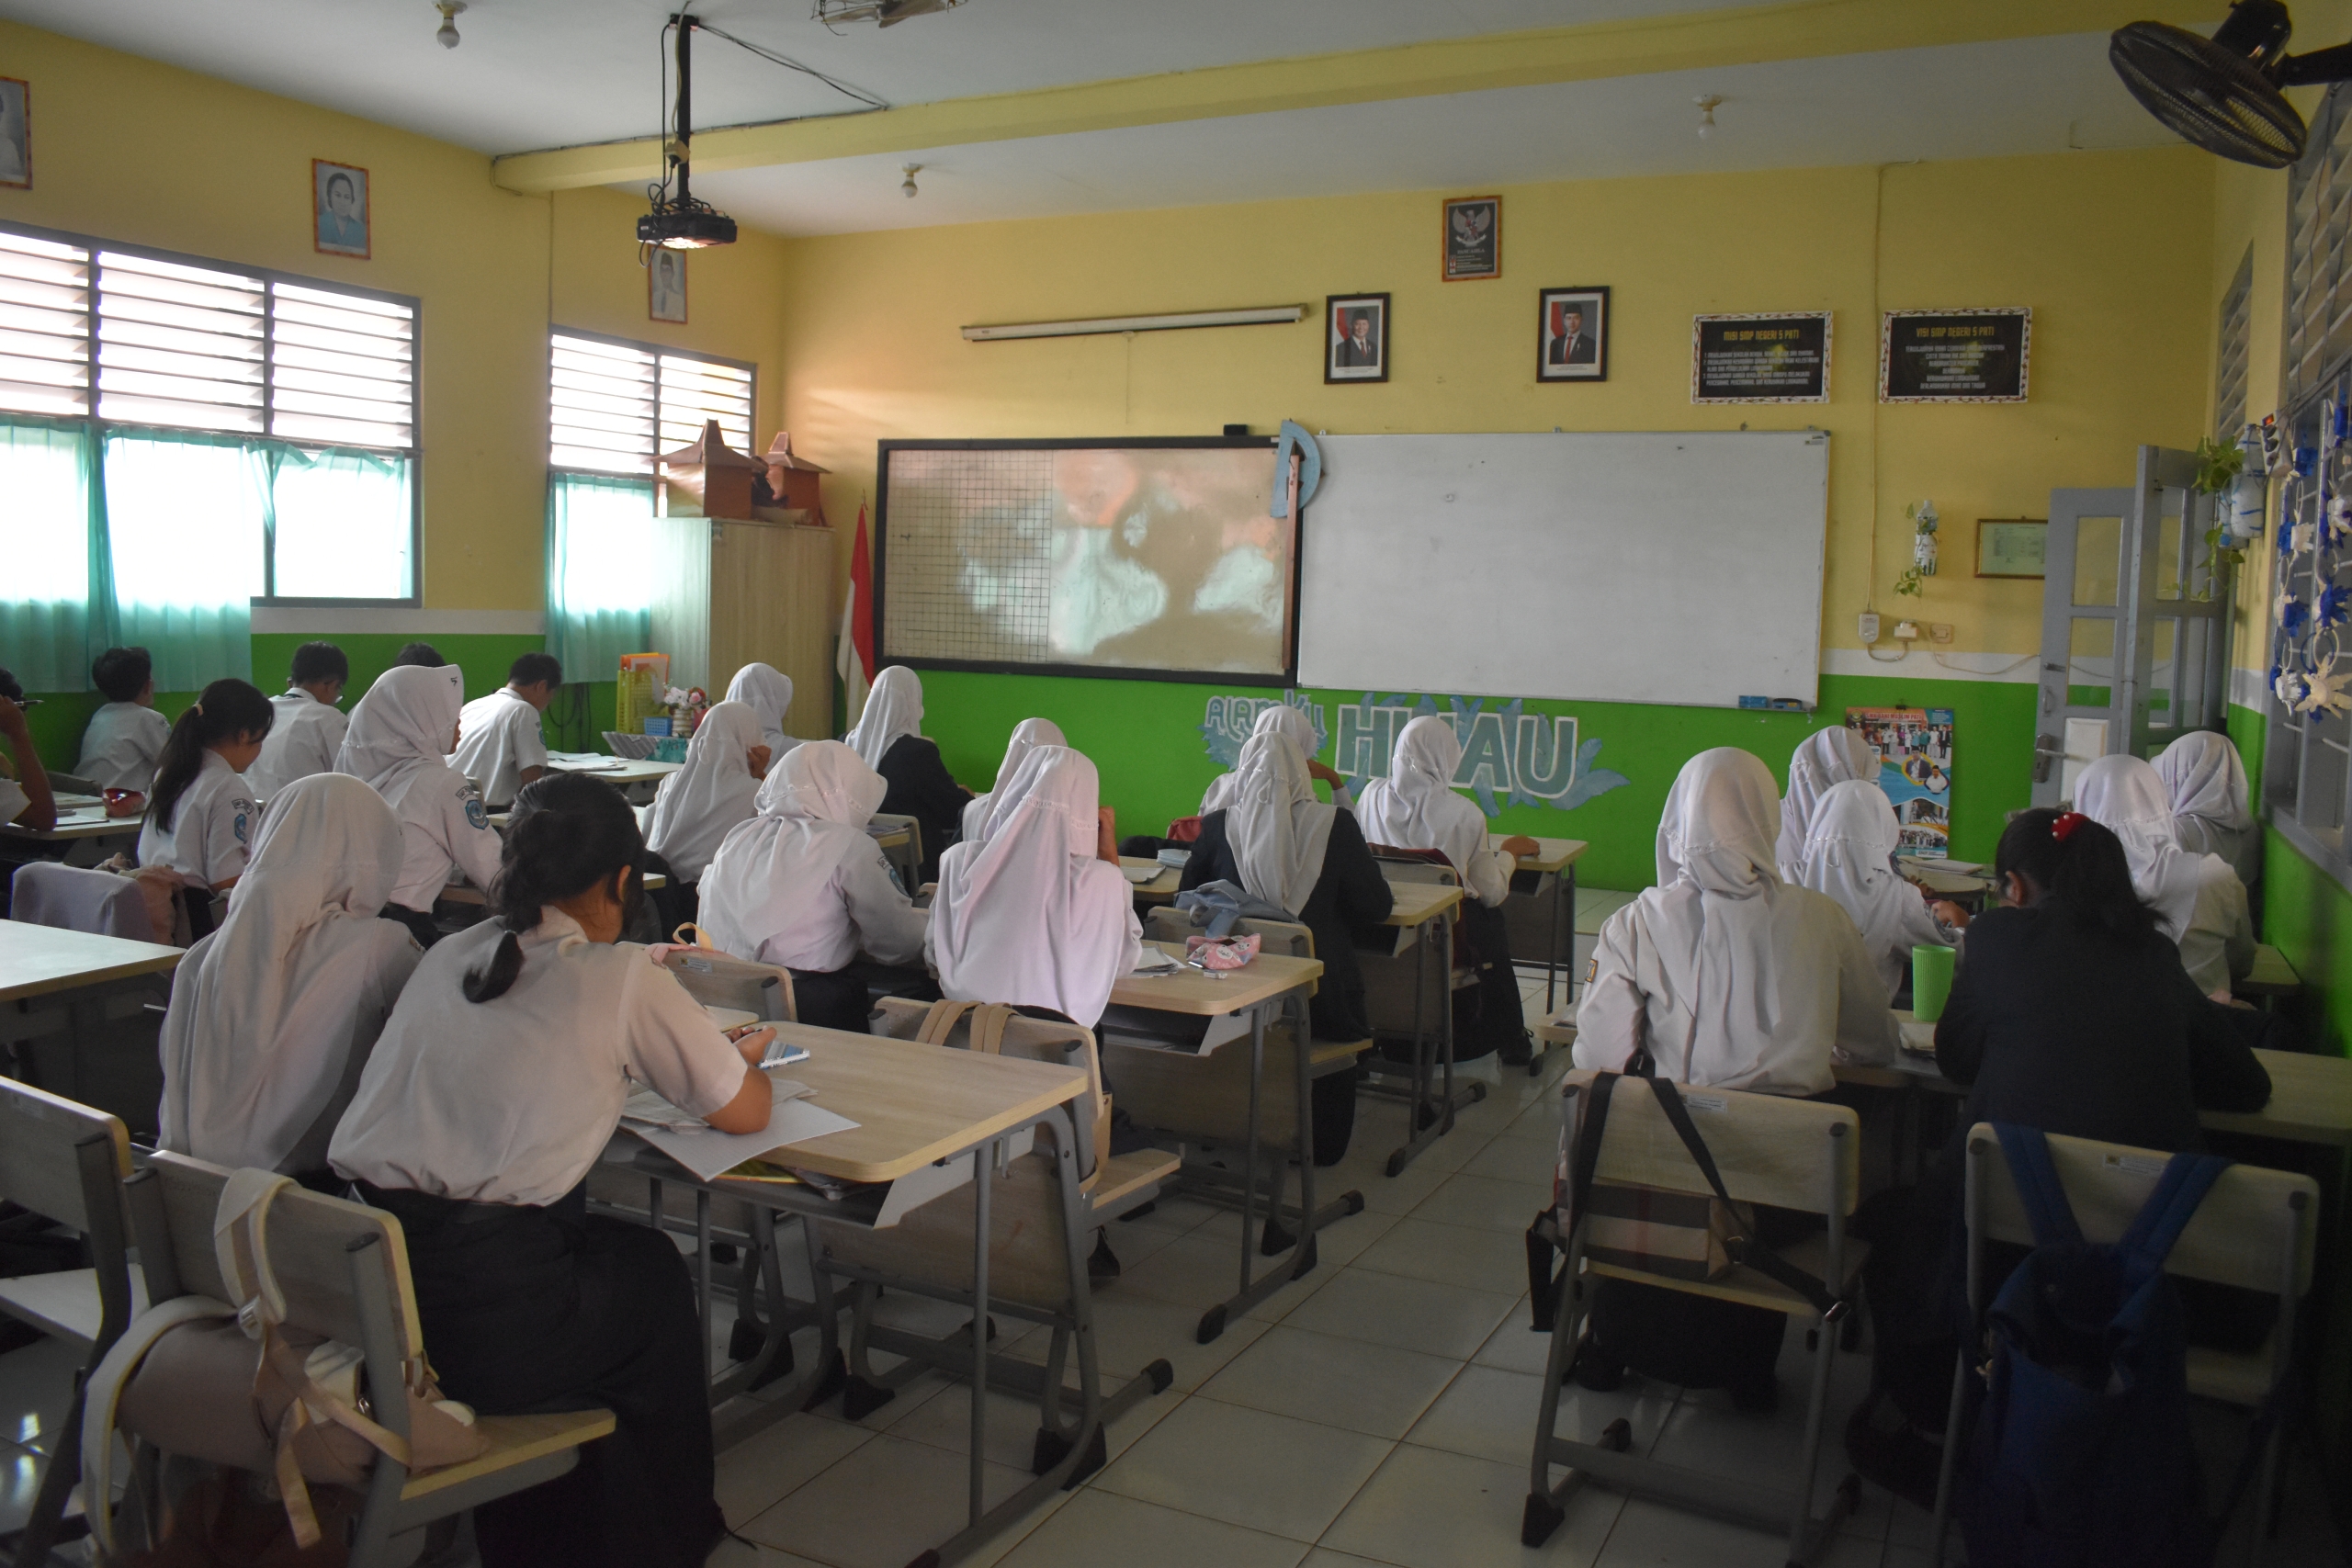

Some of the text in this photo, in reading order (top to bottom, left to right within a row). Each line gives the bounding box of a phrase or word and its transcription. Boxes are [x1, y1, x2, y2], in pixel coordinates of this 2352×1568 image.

[1784, 329, 1799, 339] PATI
[1917, 328, 1929, 337] VISI
[1948, 327, 1971, 337] NEGERI
[1979, 326, 1995, 336] PATI
[1335, 704, 1577, 798] HAU
